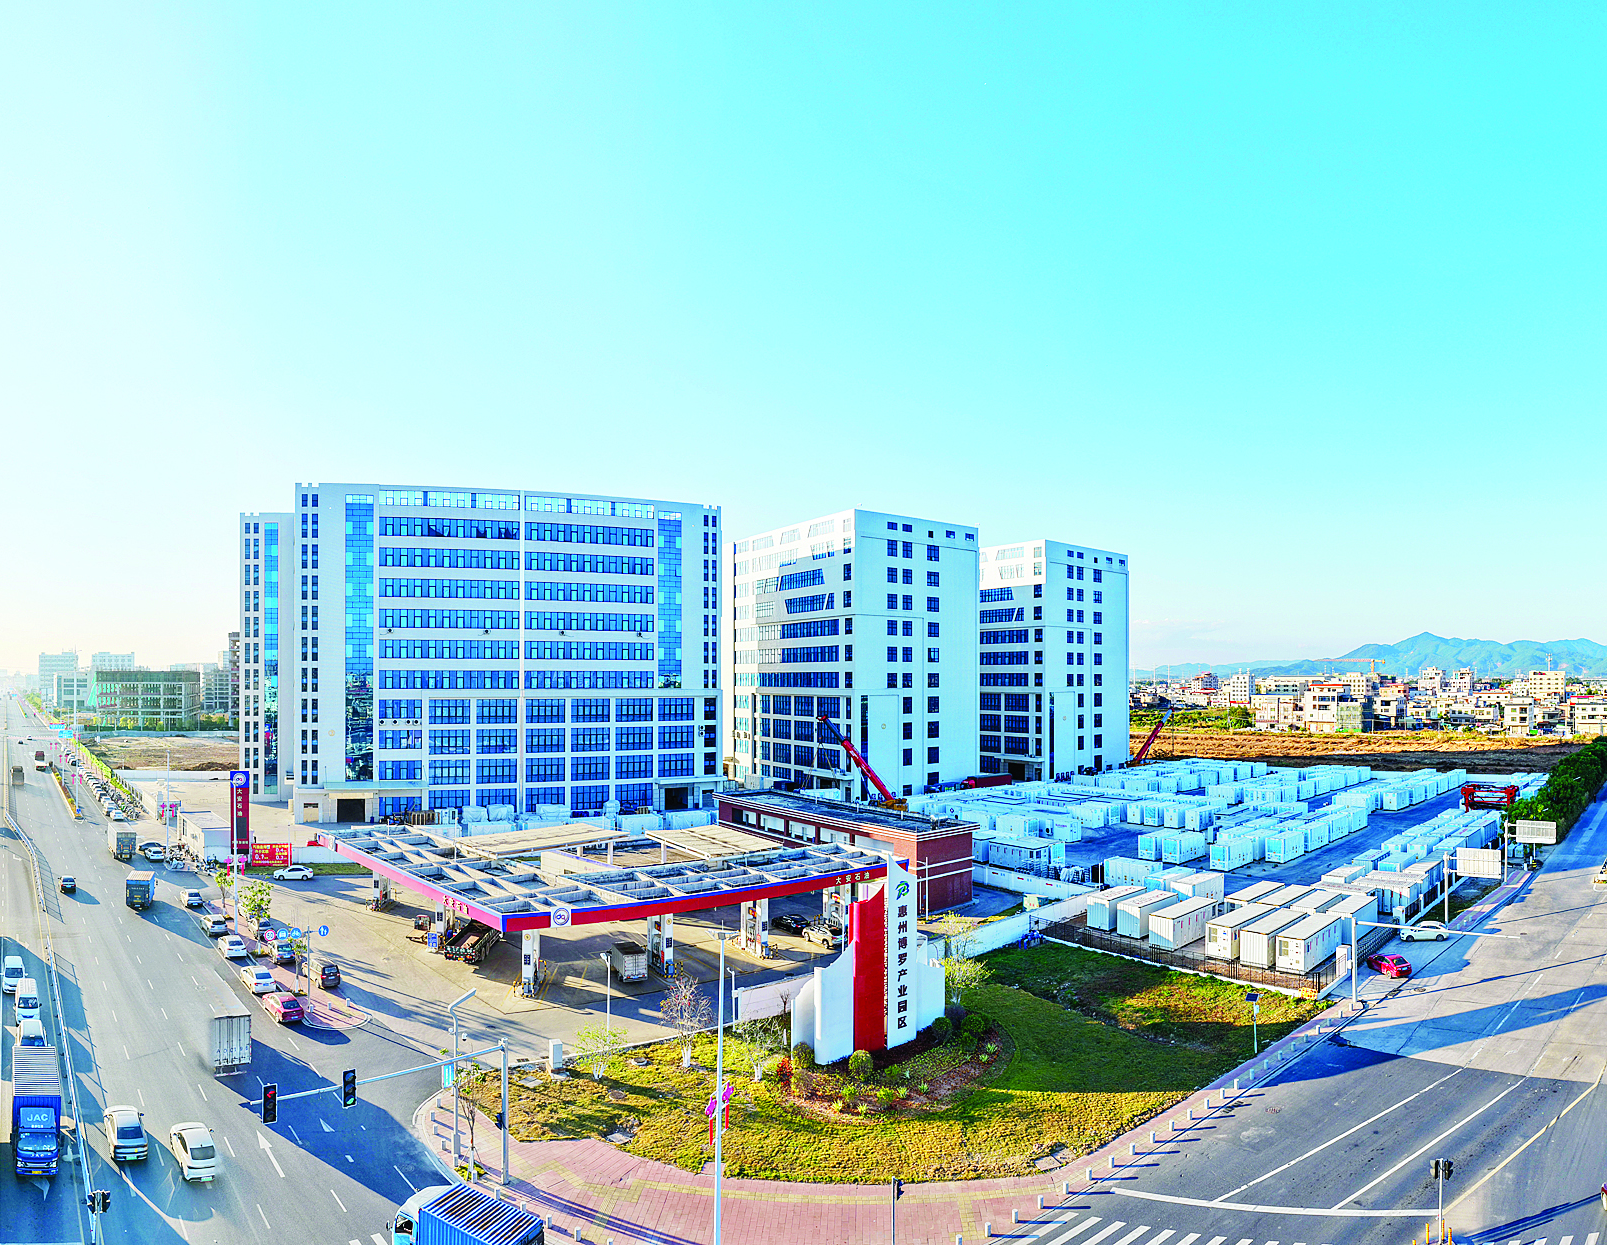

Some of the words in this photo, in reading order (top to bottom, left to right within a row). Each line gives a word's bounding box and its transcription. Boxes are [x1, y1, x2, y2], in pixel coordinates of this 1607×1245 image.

[835, 872, 870, 885] 大安石油
[897, 904, 908, 1030] 惠州博罗产业园区
[27, 1113, 48, 1121] JAC
